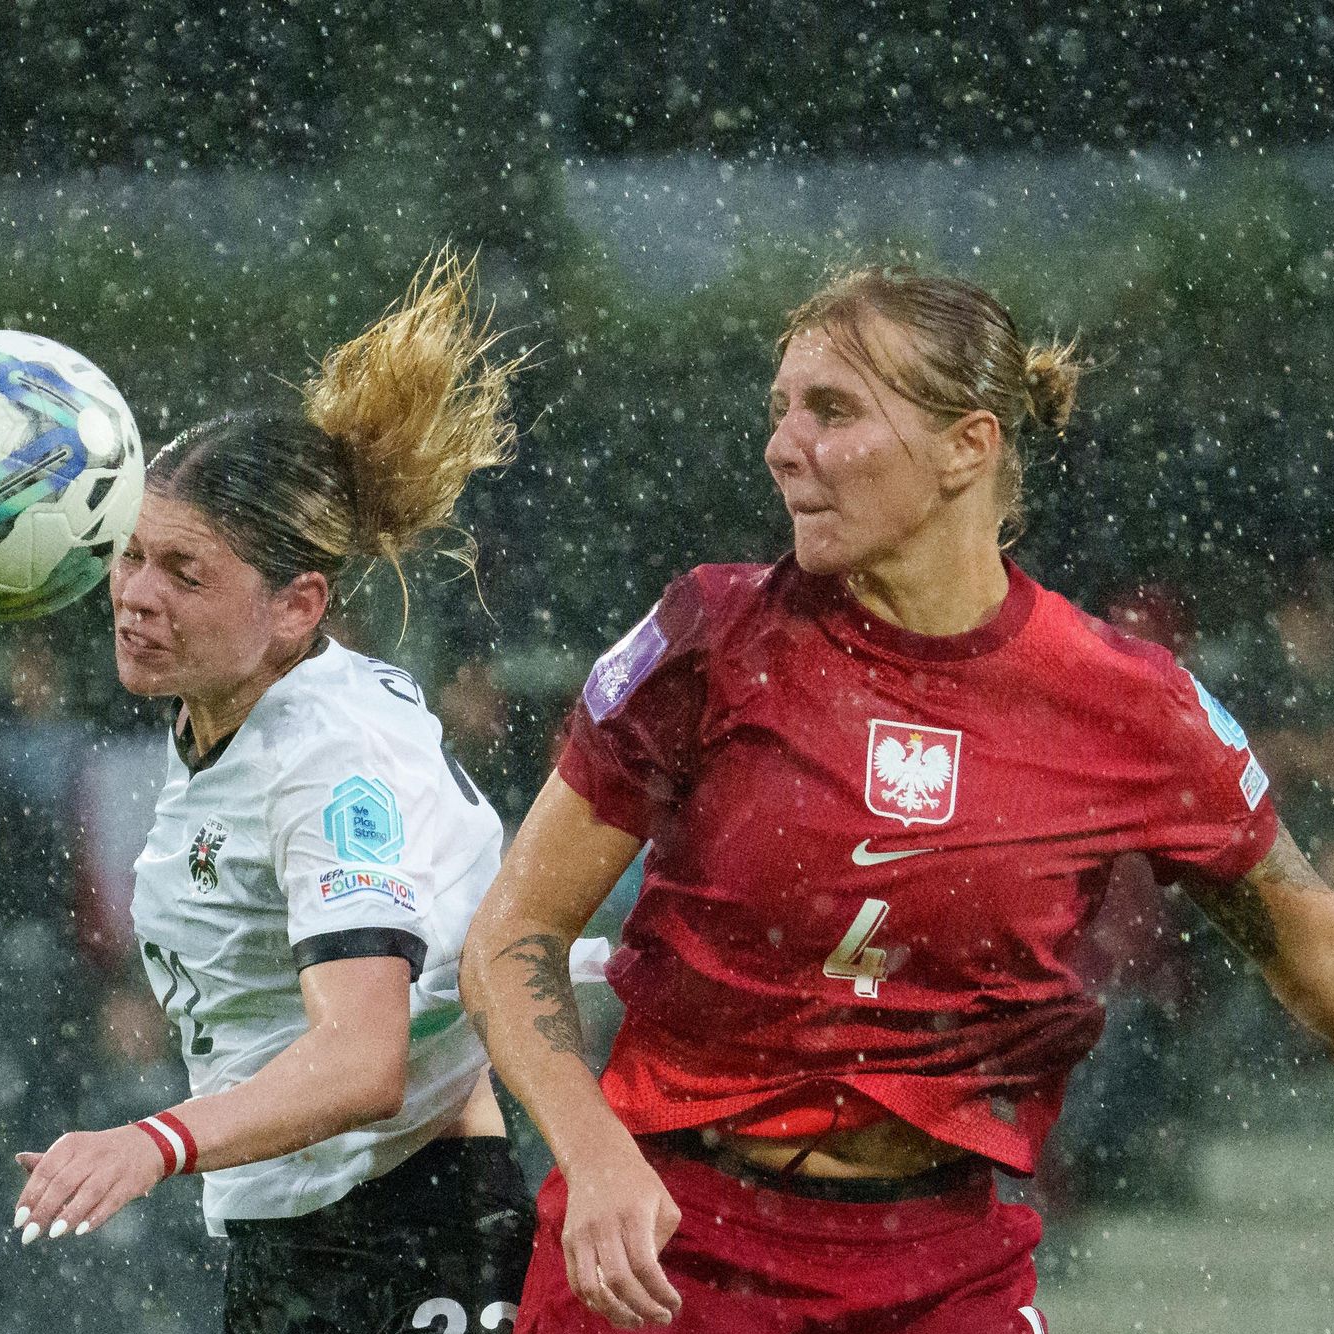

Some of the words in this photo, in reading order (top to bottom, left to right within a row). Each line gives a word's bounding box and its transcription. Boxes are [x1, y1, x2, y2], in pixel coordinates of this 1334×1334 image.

[320, 868, 344, 883] UEFA
[320, 874, 415, 902] FOUNDATION
[822, 898, 890, 998] 4
